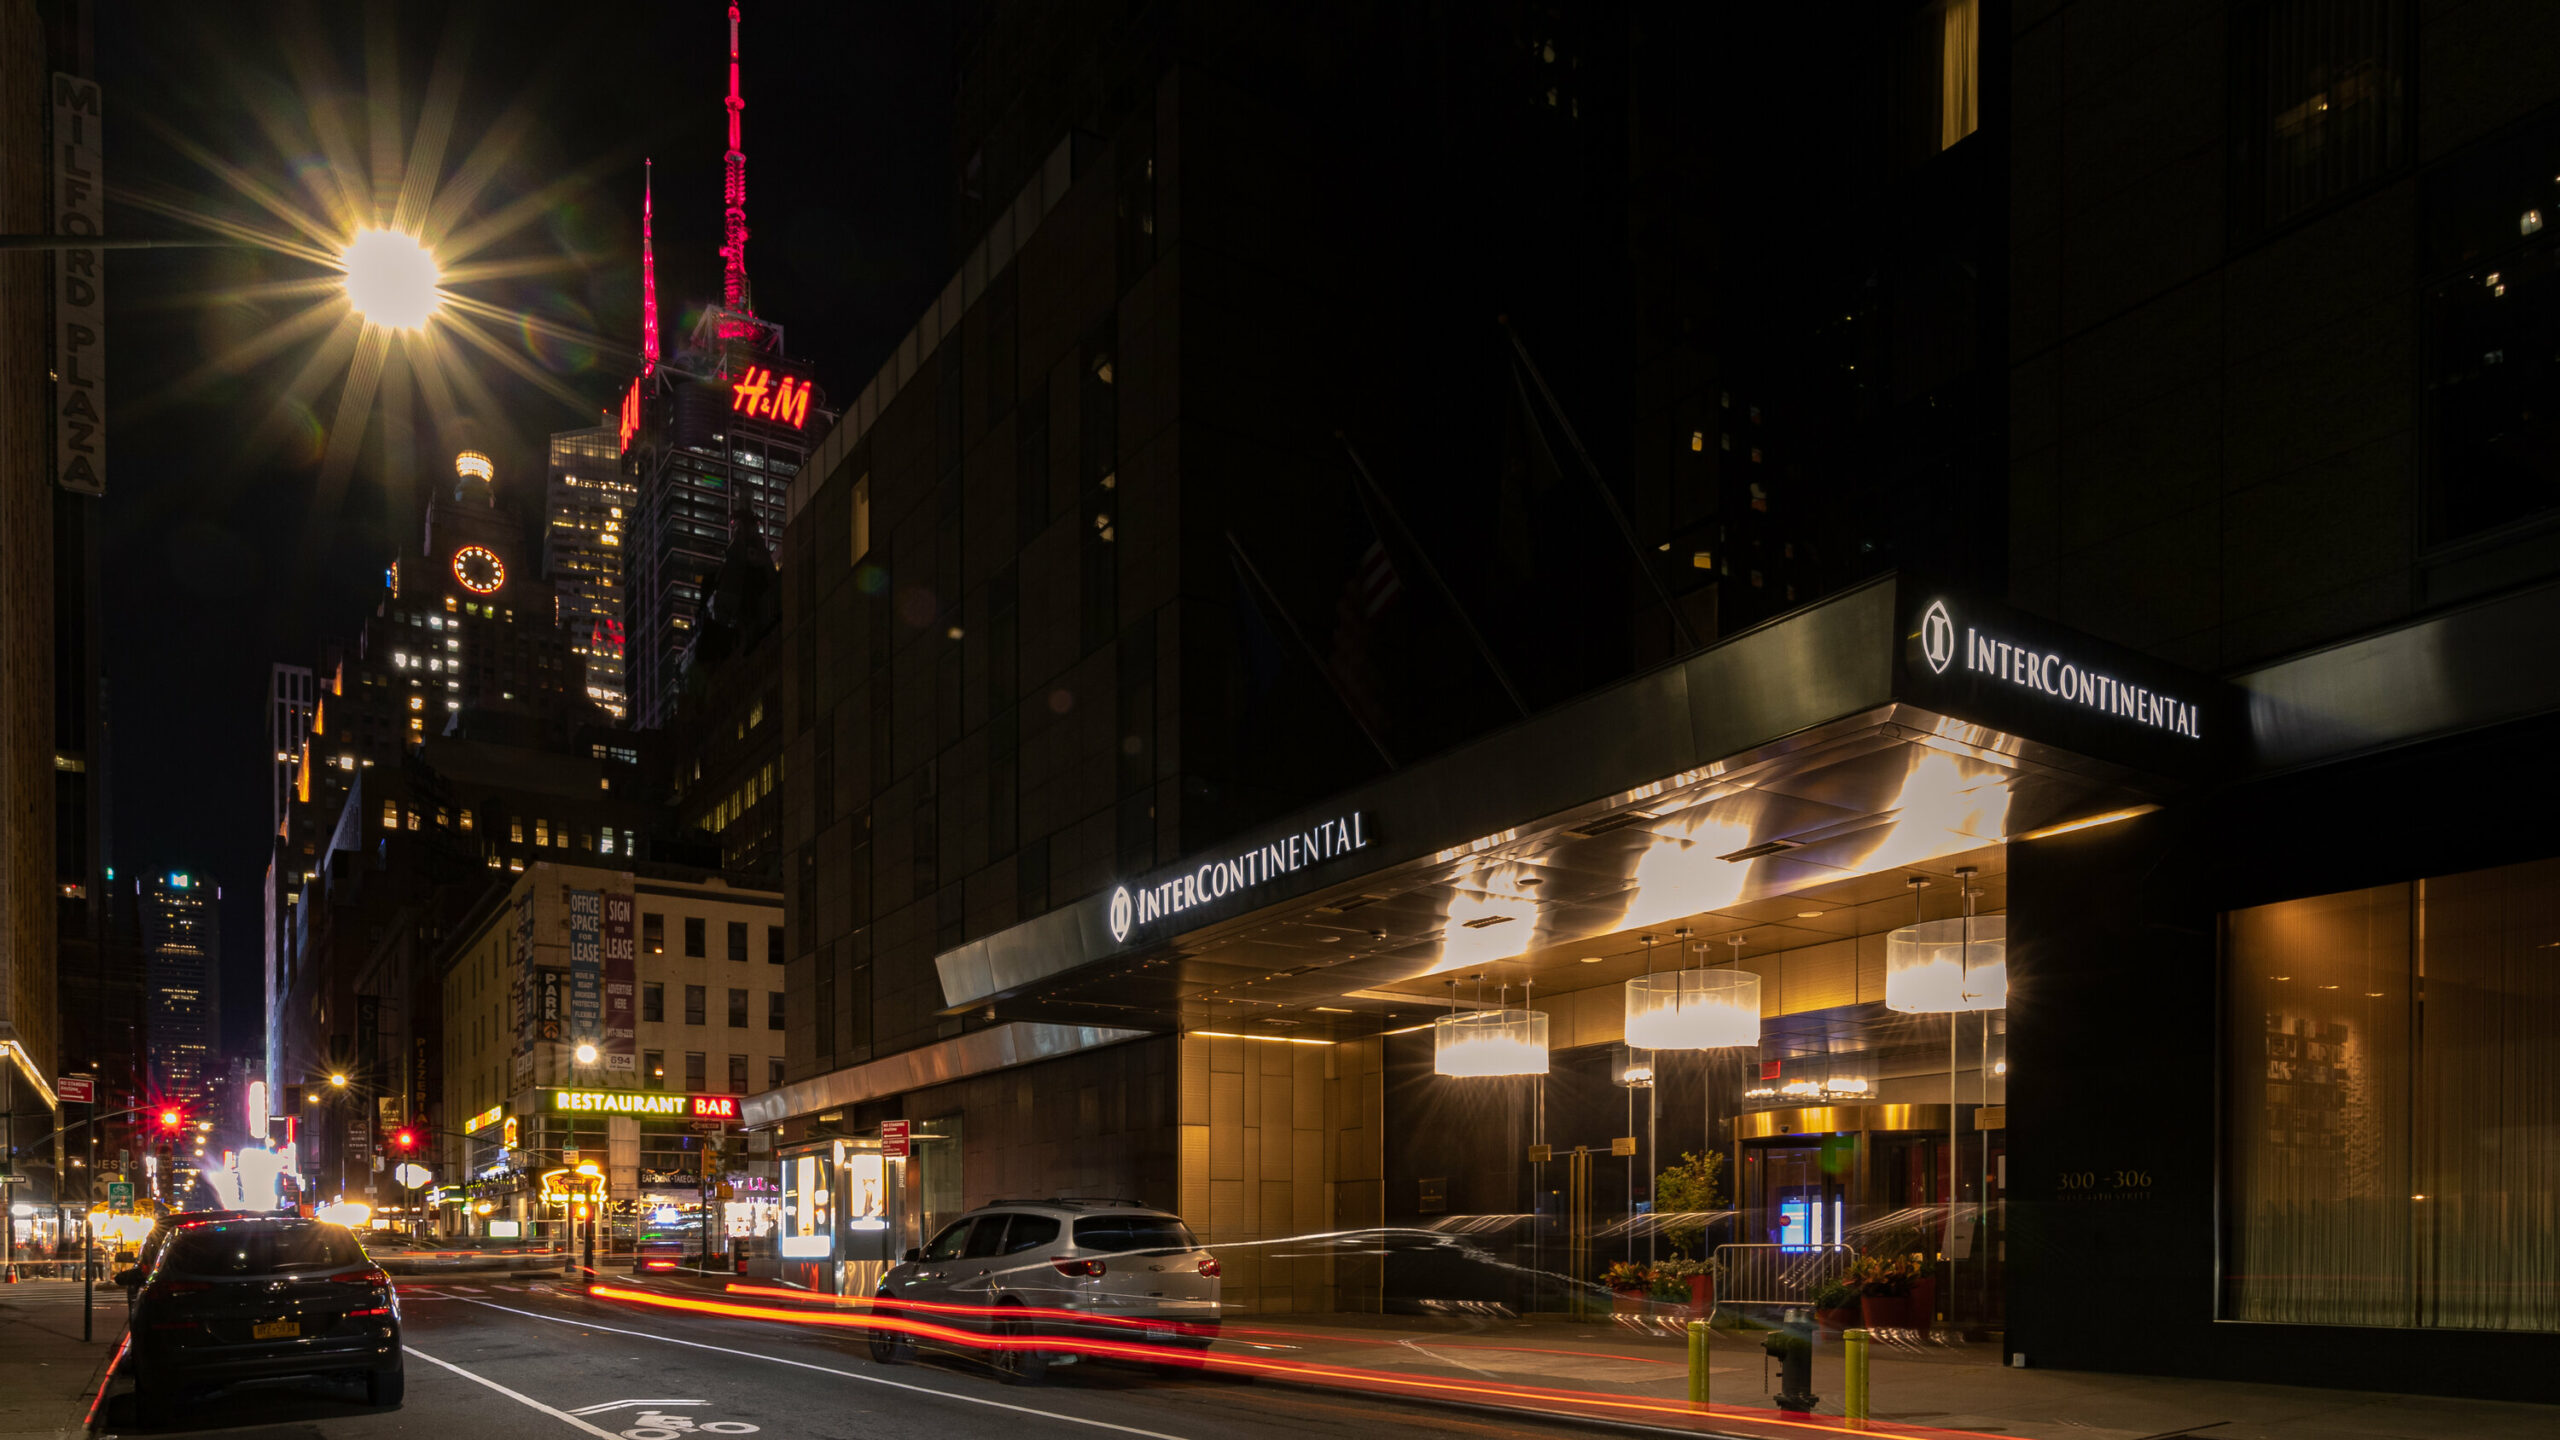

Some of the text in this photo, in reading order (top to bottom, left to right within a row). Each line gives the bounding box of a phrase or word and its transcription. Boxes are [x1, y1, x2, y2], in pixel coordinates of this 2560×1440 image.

[56, 78, 99, 487] MILFORD PLAZA
[733, 366, 811, 429] H&M
[571, 894, 599, 914] OFFICE
[609, 900, 631, 922] SIGN
[571, 914, 599, 932] SPACE
[571, 942, 599, 963] LEASE
[606, 938, 633, 960] LEASE
[545, 973, 557, 1020] PARK
[610, 1056, 631, 1065] 694
[415, 1037, 428, 1123] PIZZERIA
[556, 1092, 732, 1115] RESTAURANT BAR
[2057, 1171, 2095, 1190] 300
[2112, 1169, 2152, 1188] 306
